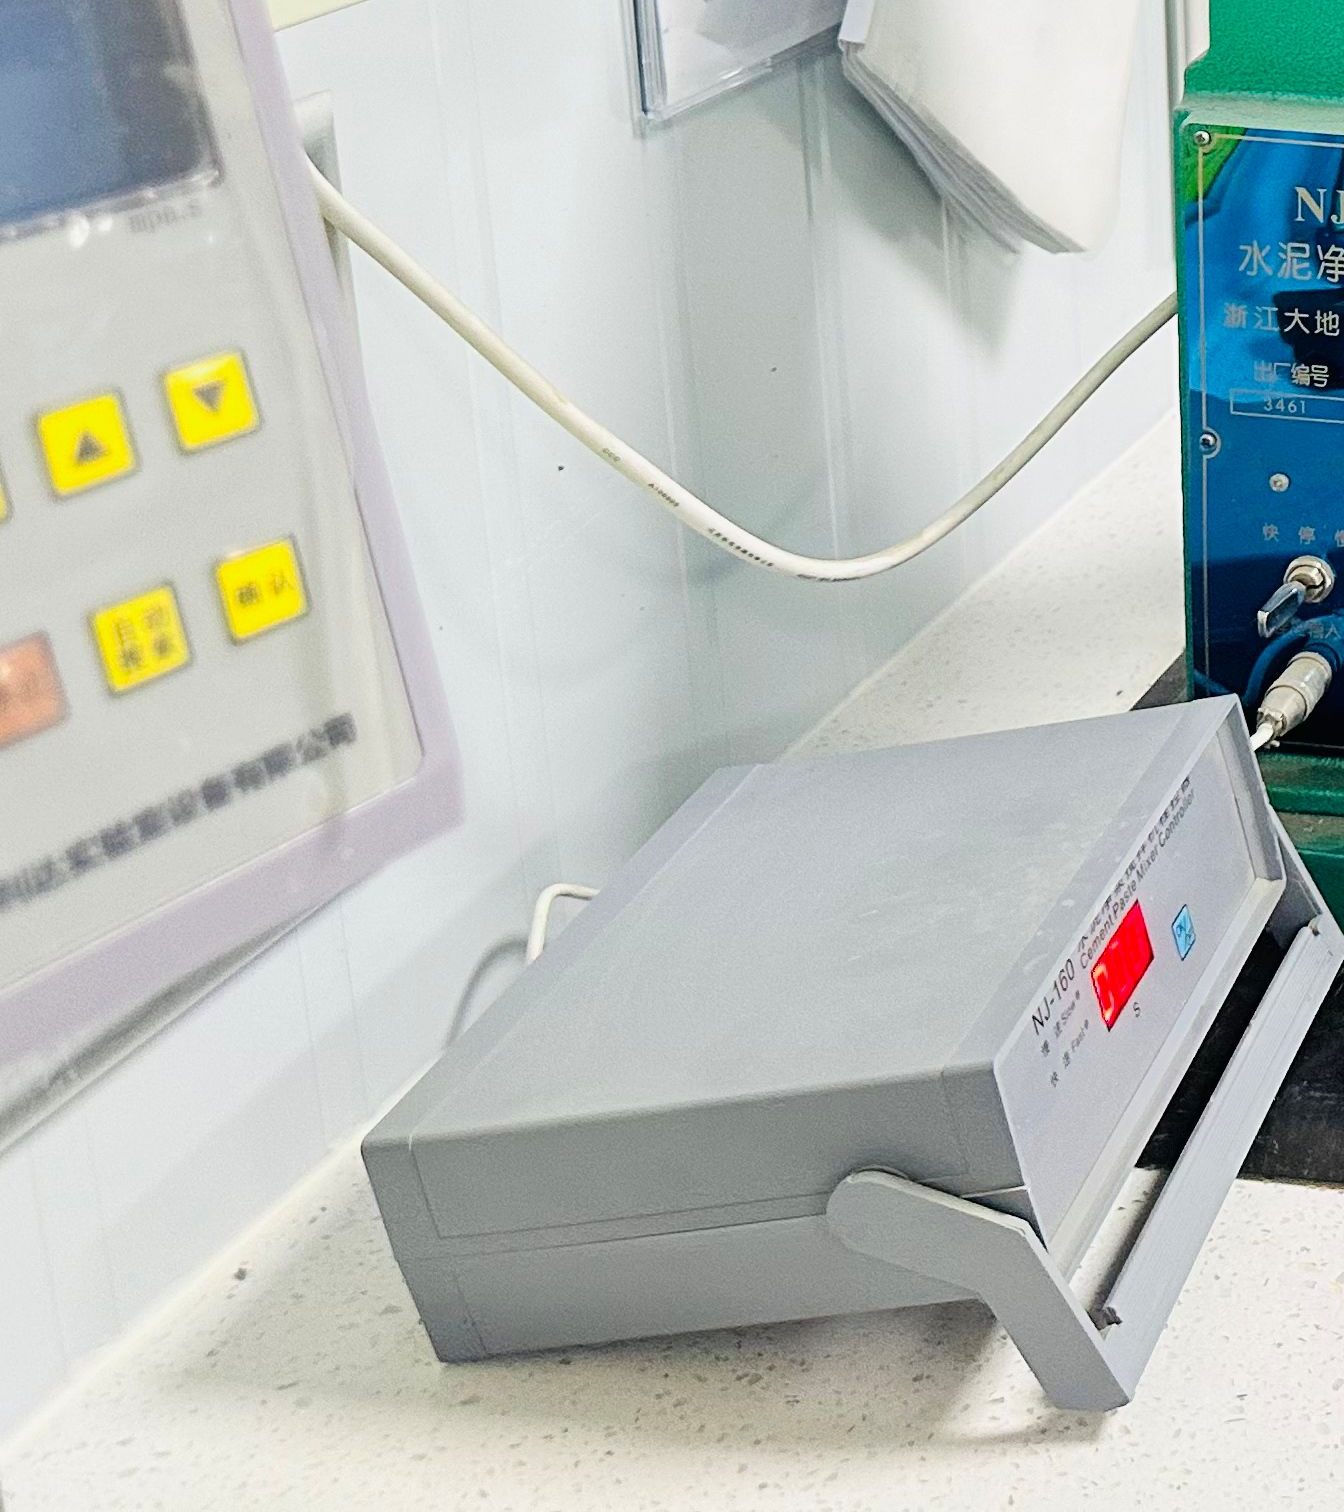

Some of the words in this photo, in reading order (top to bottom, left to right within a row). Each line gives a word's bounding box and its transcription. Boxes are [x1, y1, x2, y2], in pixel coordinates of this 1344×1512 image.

[1253, 359, 1330, 388] 出厂编号
[1263, 398, 1307, 413] 3461
[1113, 880, 1138, 921] Paste
[1031, 958, 1075, 1036] NJ-160
